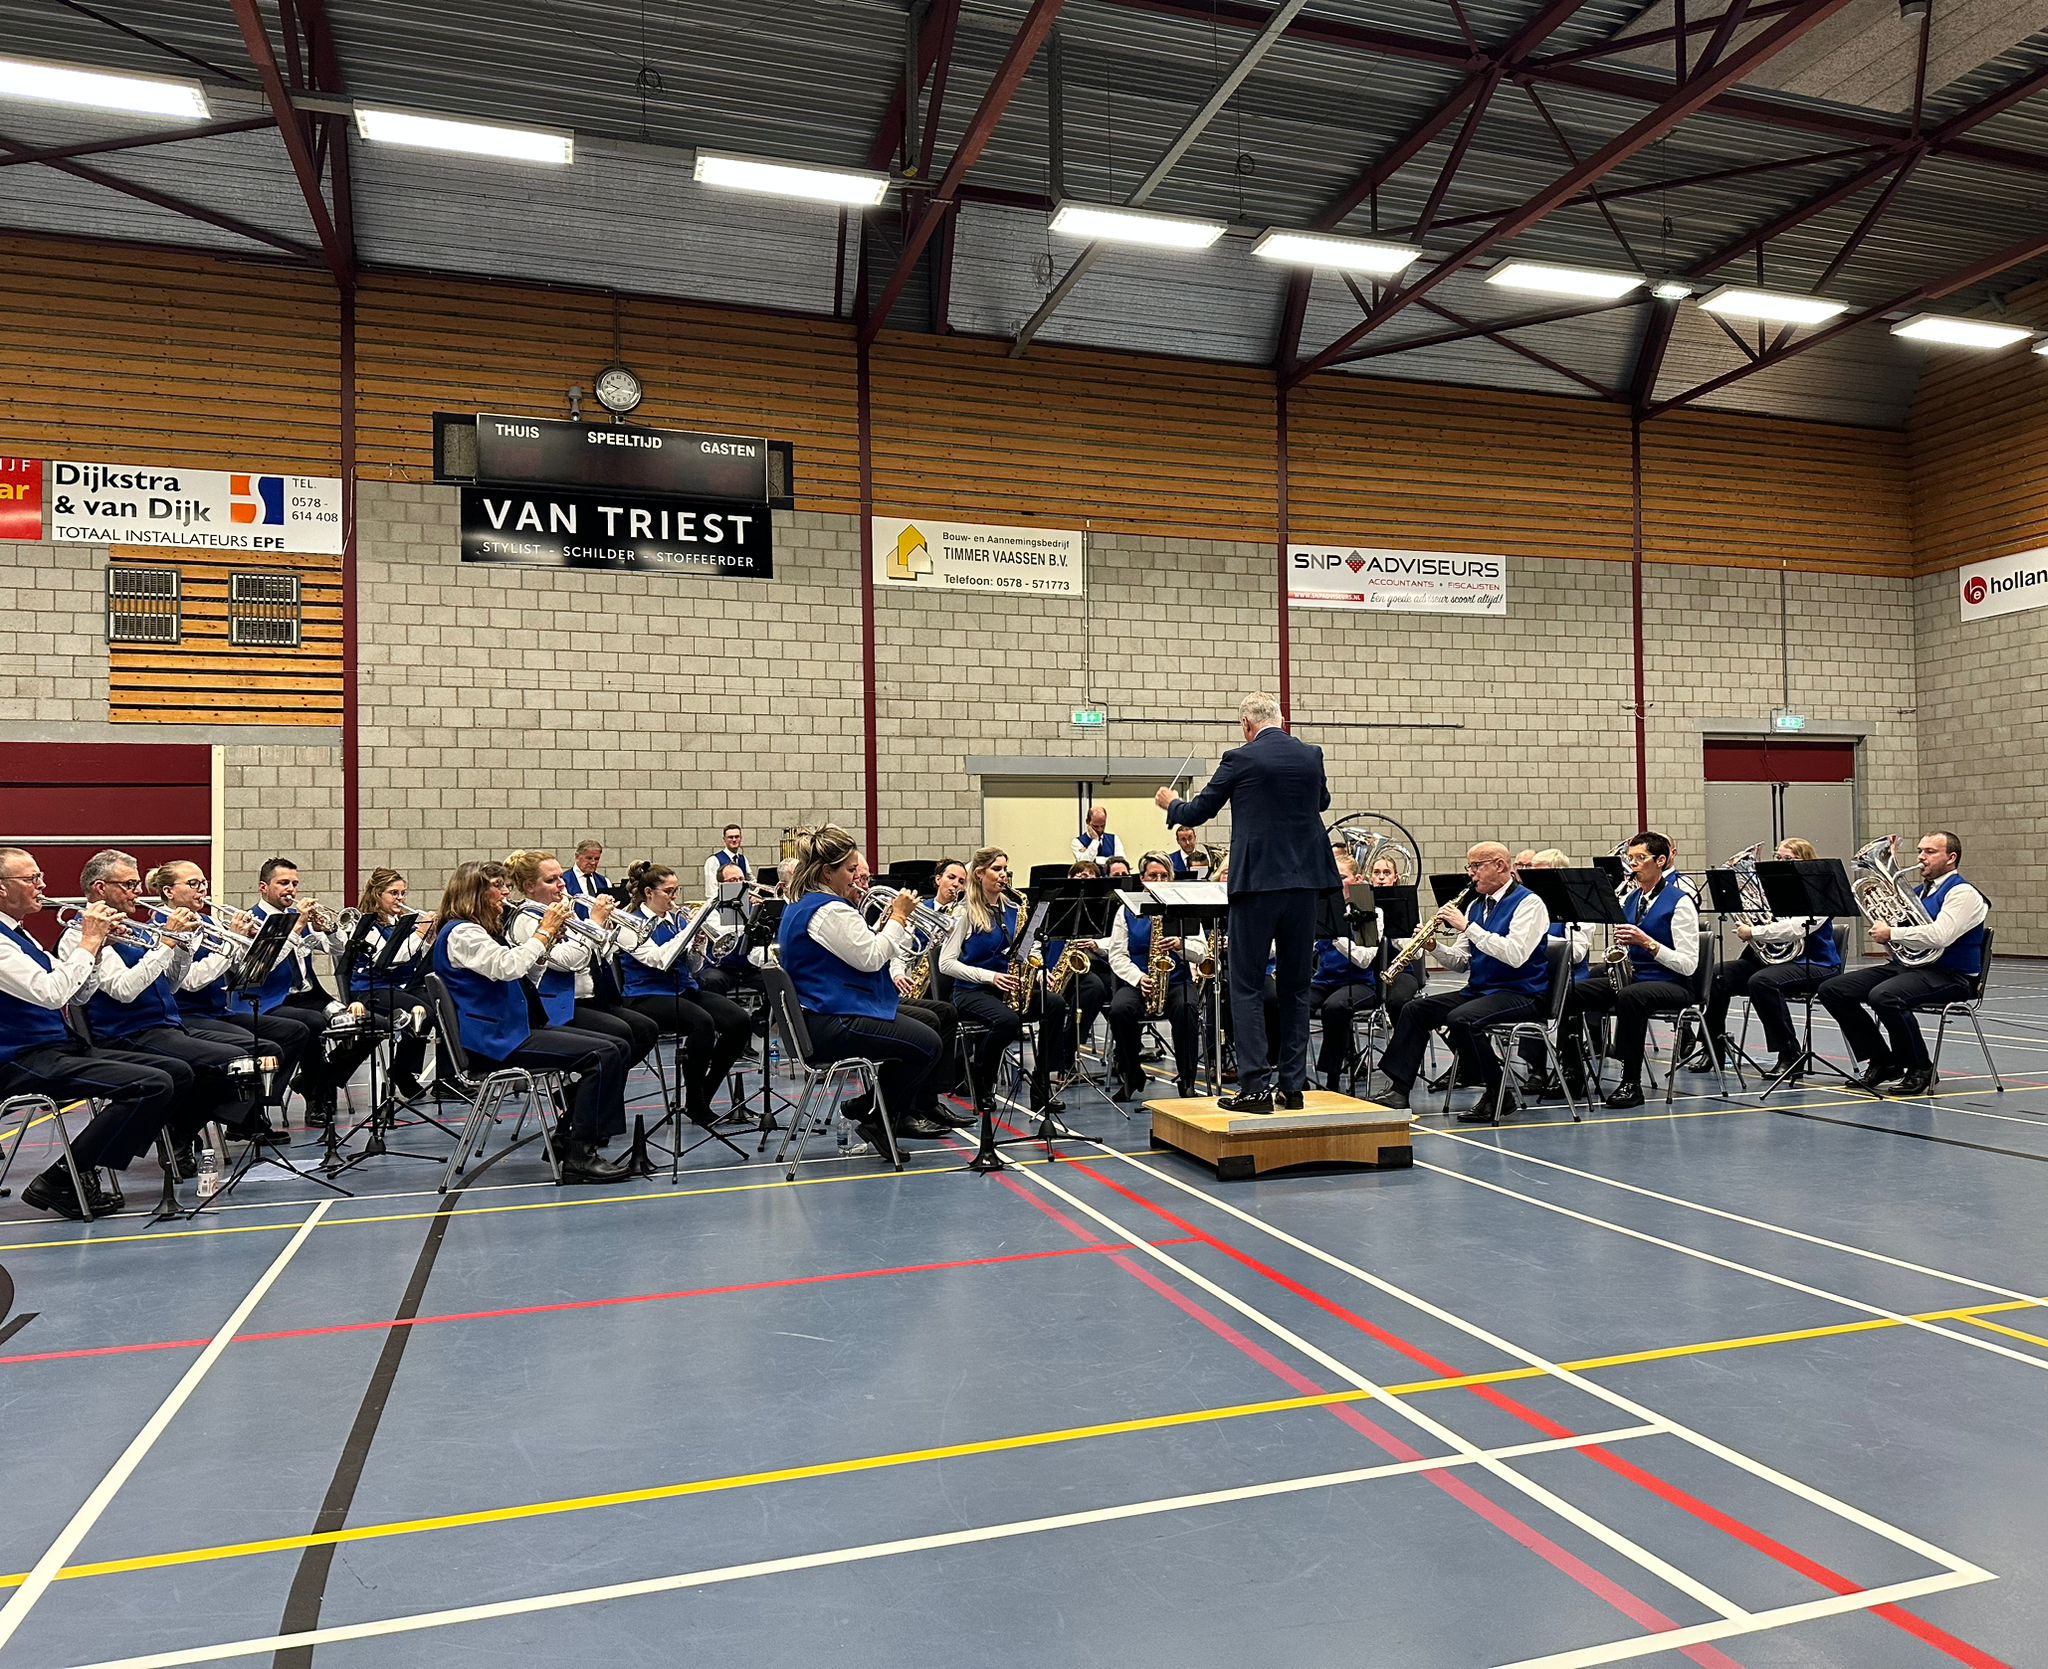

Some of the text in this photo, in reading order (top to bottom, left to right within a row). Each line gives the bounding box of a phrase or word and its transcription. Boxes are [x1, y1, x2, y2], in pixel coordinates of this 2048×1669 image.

[495, 423, 756, 458] THUIS SPEELTIJD GASTEN
[55, 463, 181, 493] Dijkstra
[292, 477, 317, 489] TEL.
[54, 495, 211, 527] & van Dijk
[291, 496, 322, 508] 0578
[291, 510, 339, 523] 614 408
[482, 498, 753, 545] VAN TRIEST
[56, 526, 285, 549] TOTAAL INSTALLATEURS EPE
[942, 531, 1070, 550] Bouw- en Aannemingsbedrijf
[482, 541, 541, 555] STYLIST
[562, 546, 636, 562] SCHILDER
[656, 551, 754, 568] STOFFEERDER
[943, 546, 1068, 567] TIMMER VAASSEN B.V.
[1294, 553, 1499, 578] SNP ADVISEURS
[943, 573, 994, 586] Telefoon:
[996, 577, 1023, 588] 0578
[1032, 579, 1070, 591] 571773
[1368, 578, 1500, 591] ACCOUNTANTS FISCALISTEN
[1370, 592, 1385, 603] Een
[1386, 593, 1411, 608] goede
[1476, 593, 1504, 609] altijd!
